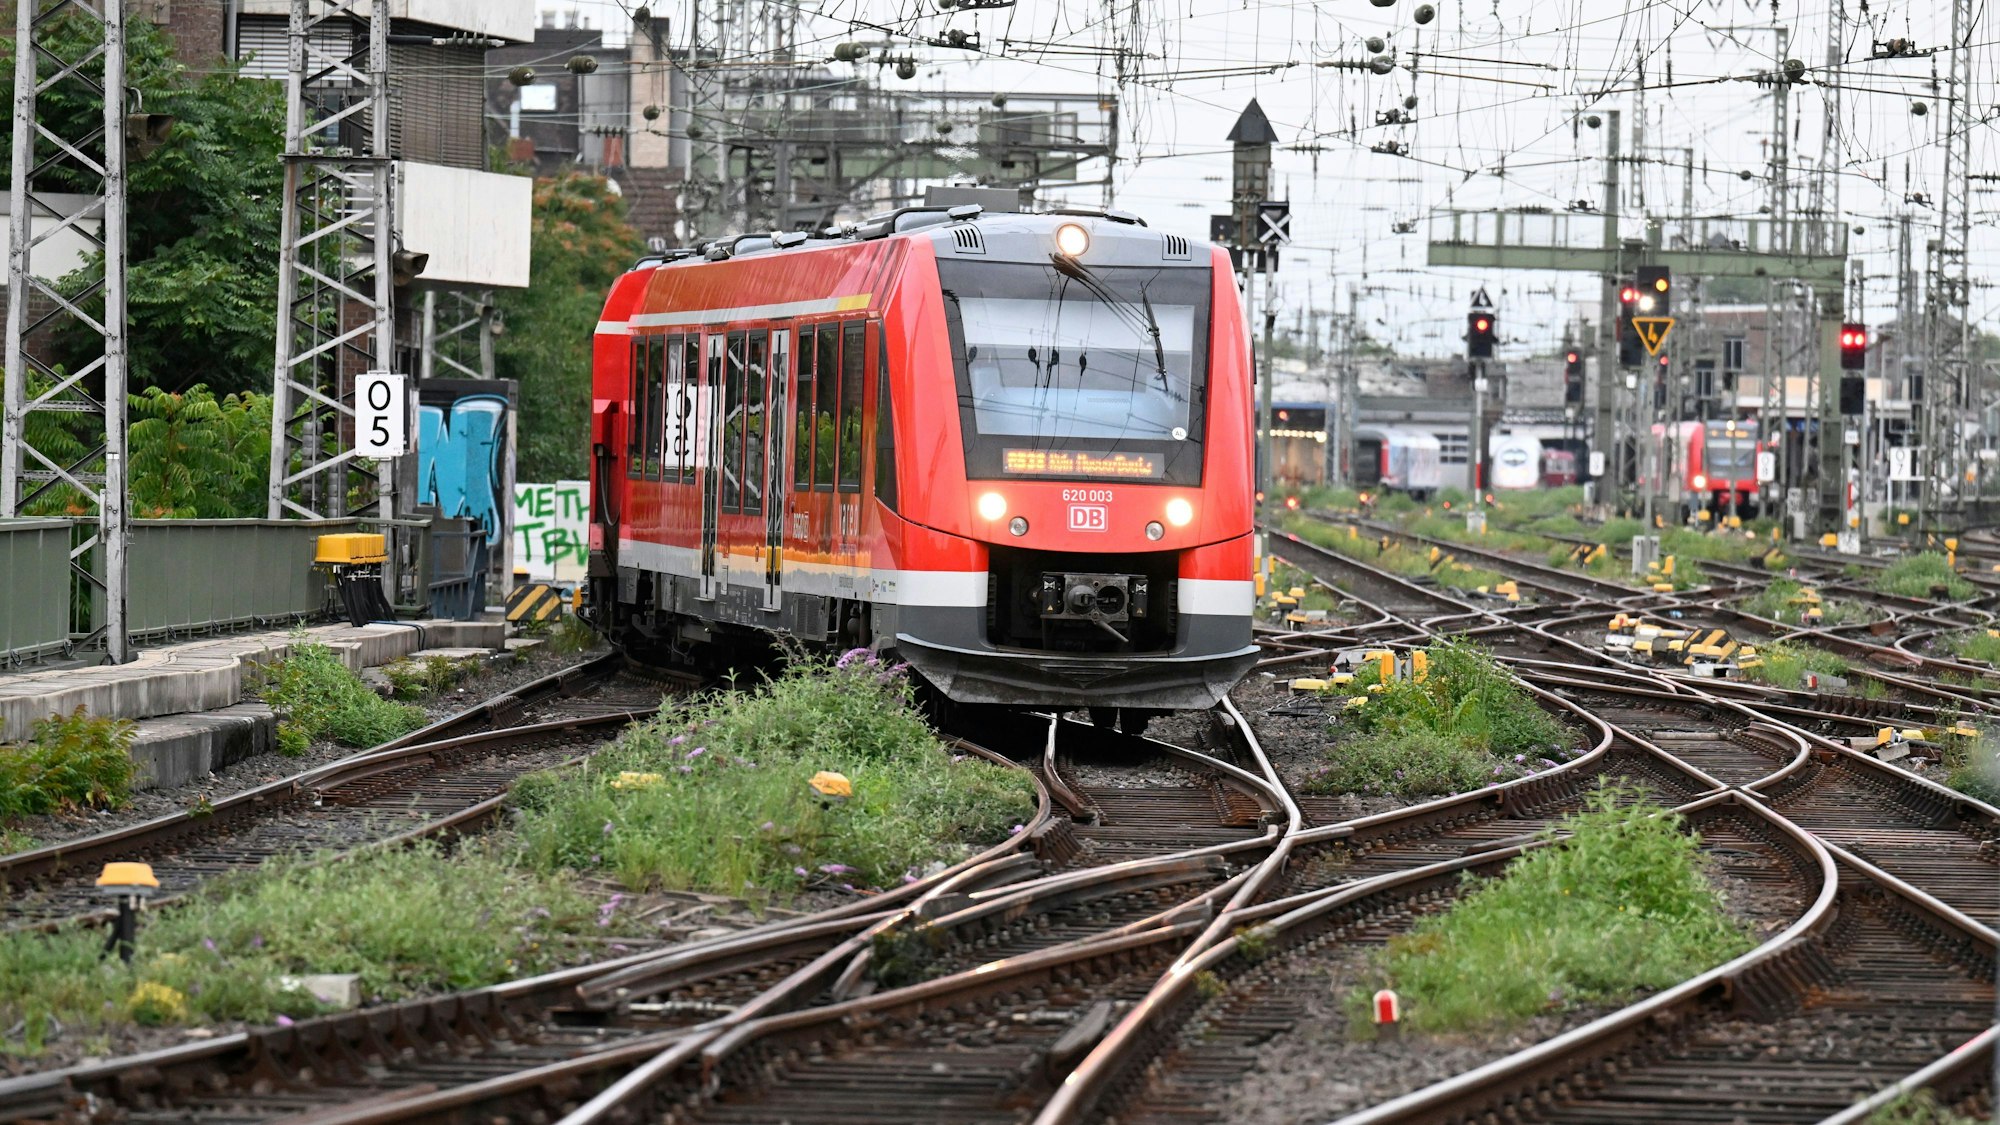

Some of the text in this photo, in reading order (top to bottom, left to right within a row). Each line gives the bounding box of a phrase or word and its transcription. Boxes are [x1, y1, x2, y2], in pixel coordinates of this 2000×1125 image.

[1062, 489, 1113, 503] 620 003
[1073, 508, 1104, 528] DB
